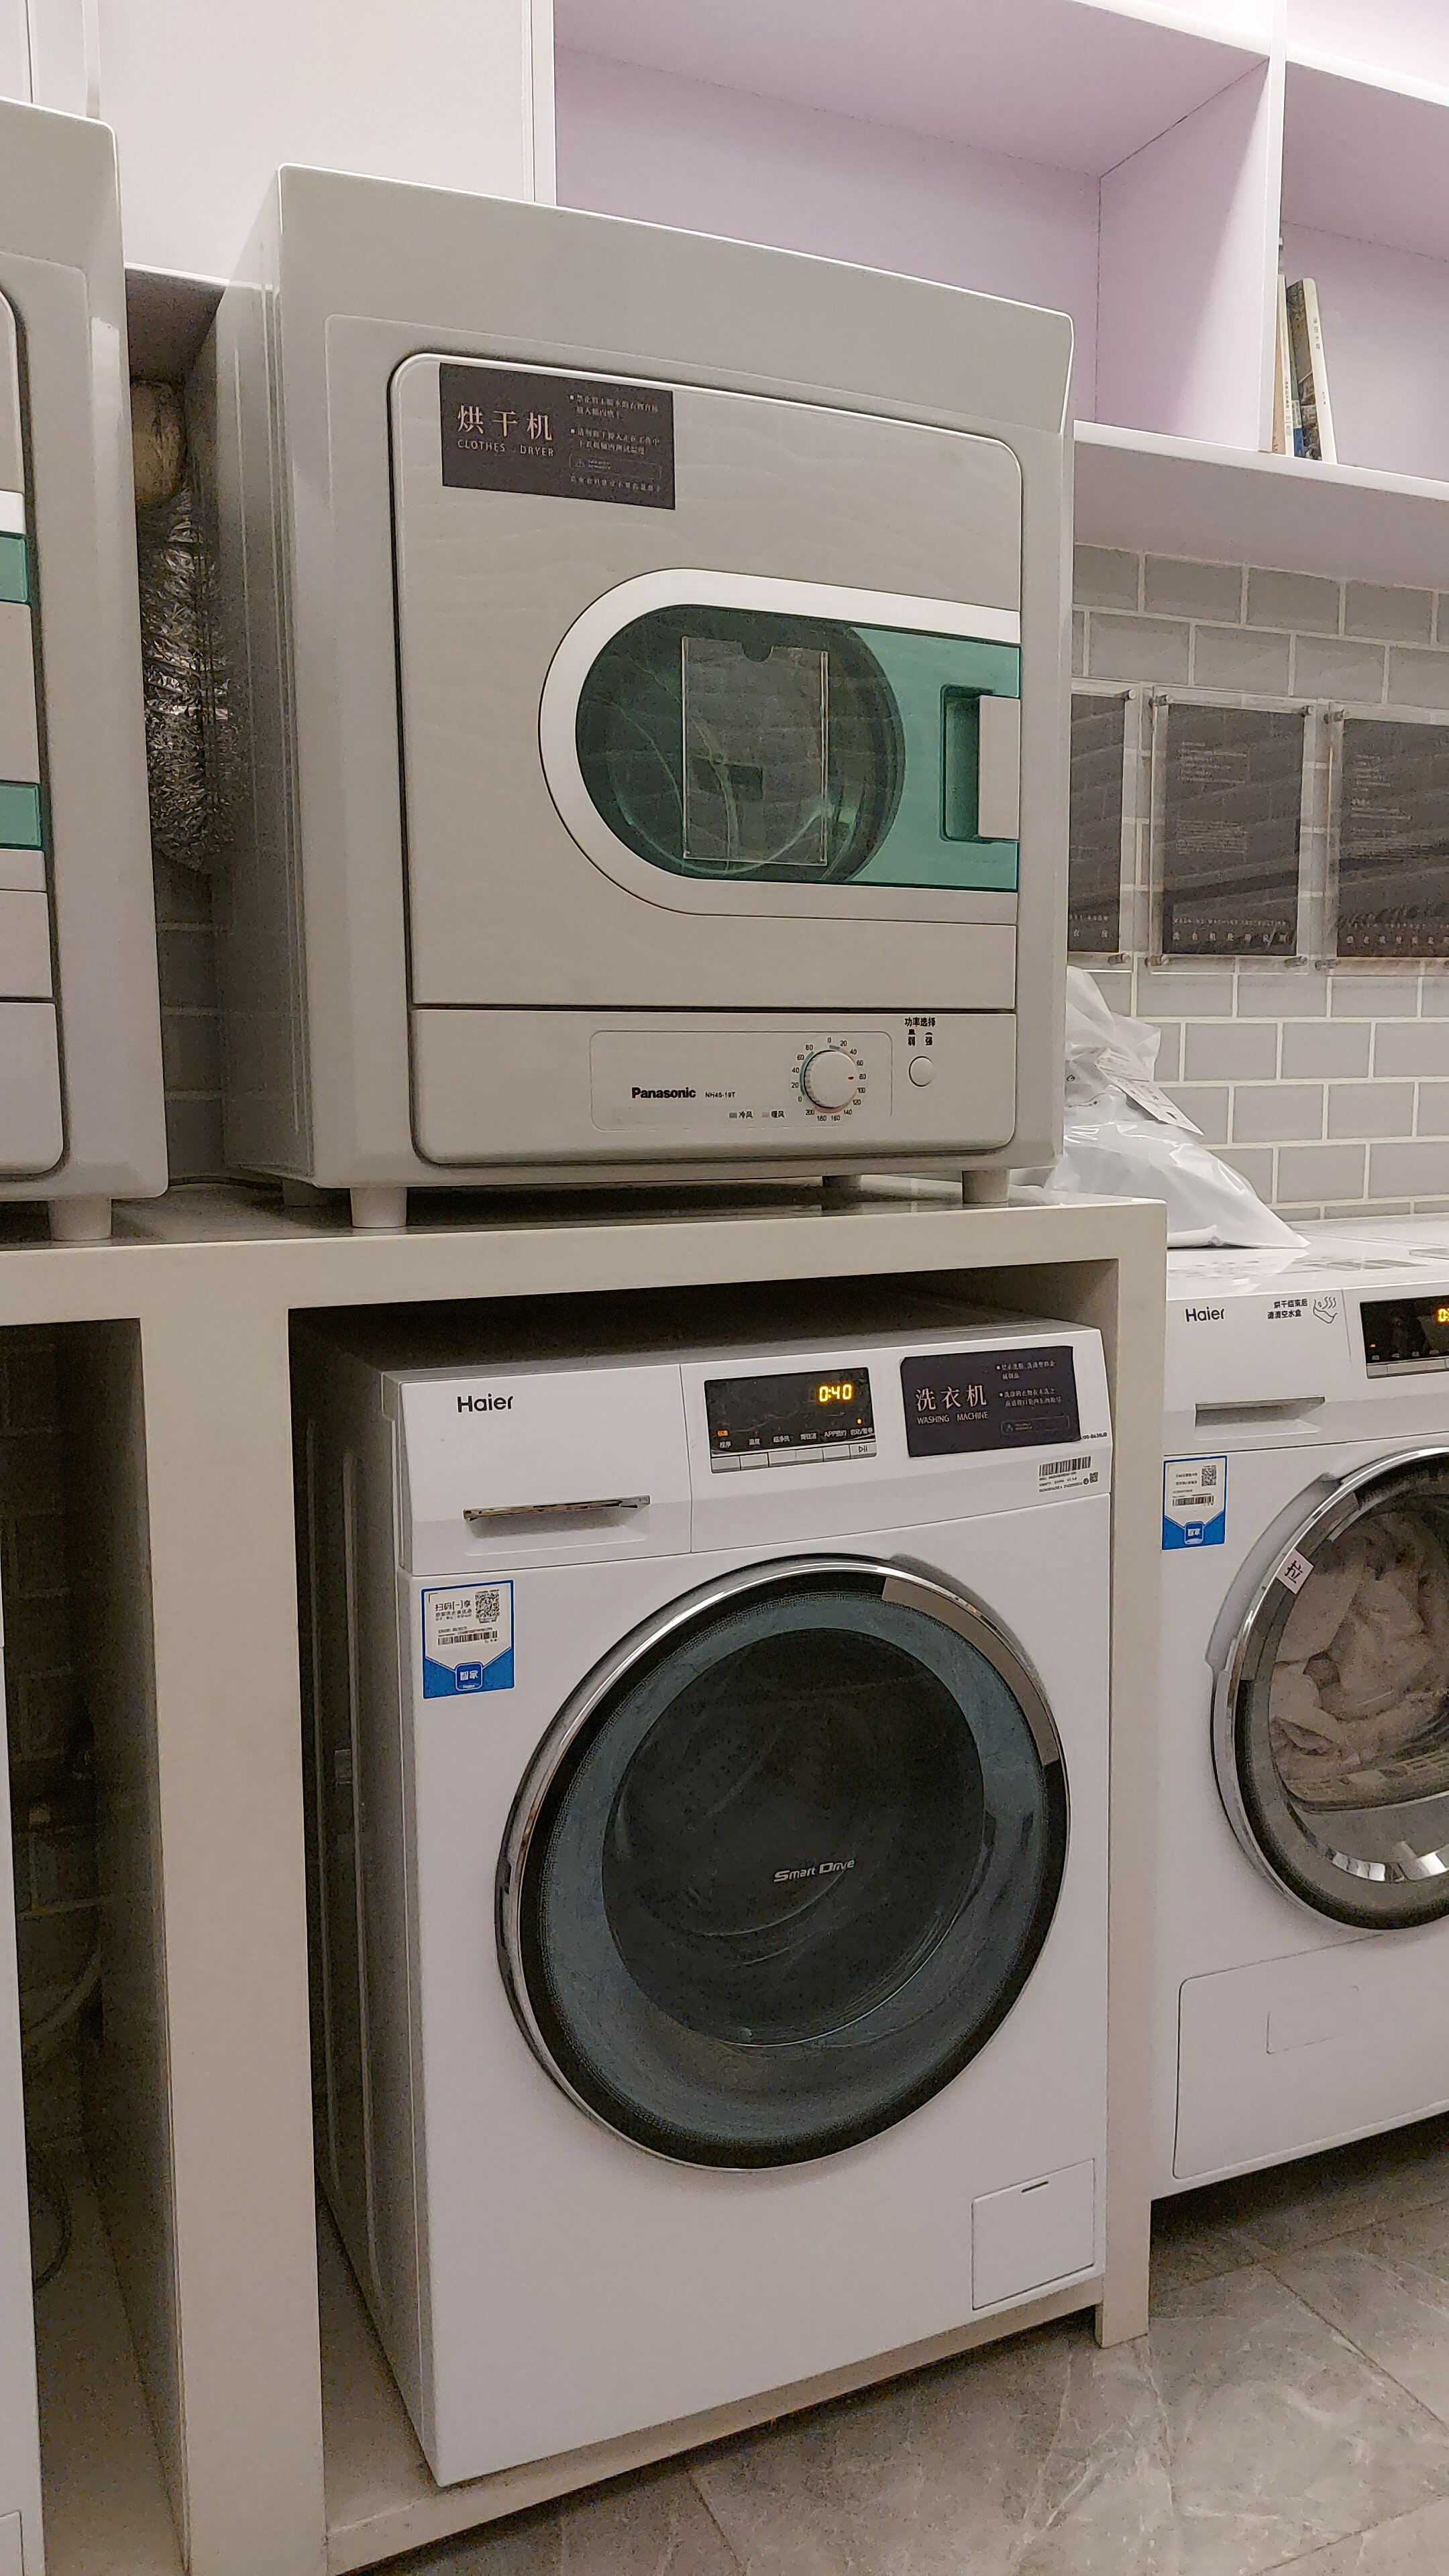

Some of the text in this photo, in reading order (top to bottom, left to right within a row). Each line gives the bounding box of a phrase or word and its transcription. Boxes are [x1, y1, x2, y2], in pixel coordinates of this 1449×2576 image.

[457, 404, 553, 441] 烘干机
[457, 439, 554, 457] CLOTHES DRYER
[904, 1016, 936, 1027] 功率选择
[631, 1087, 696, 1099] Panasonic
[739, 1111, 753, 1119] 冷风
[1185, 1306, 1225, 1322] Haier
[819, 1384, 853, 1402] 0:40
[915, 1384, 987, 1411] 洗衣机
[457, 1393, 514, 1413] Haier
[916, 1411, 989, 1425] WASHING MACHINE
[1284, 1560, 1303, 1584] 拉
[773, 1859, 855, 1883] Smart Drive
